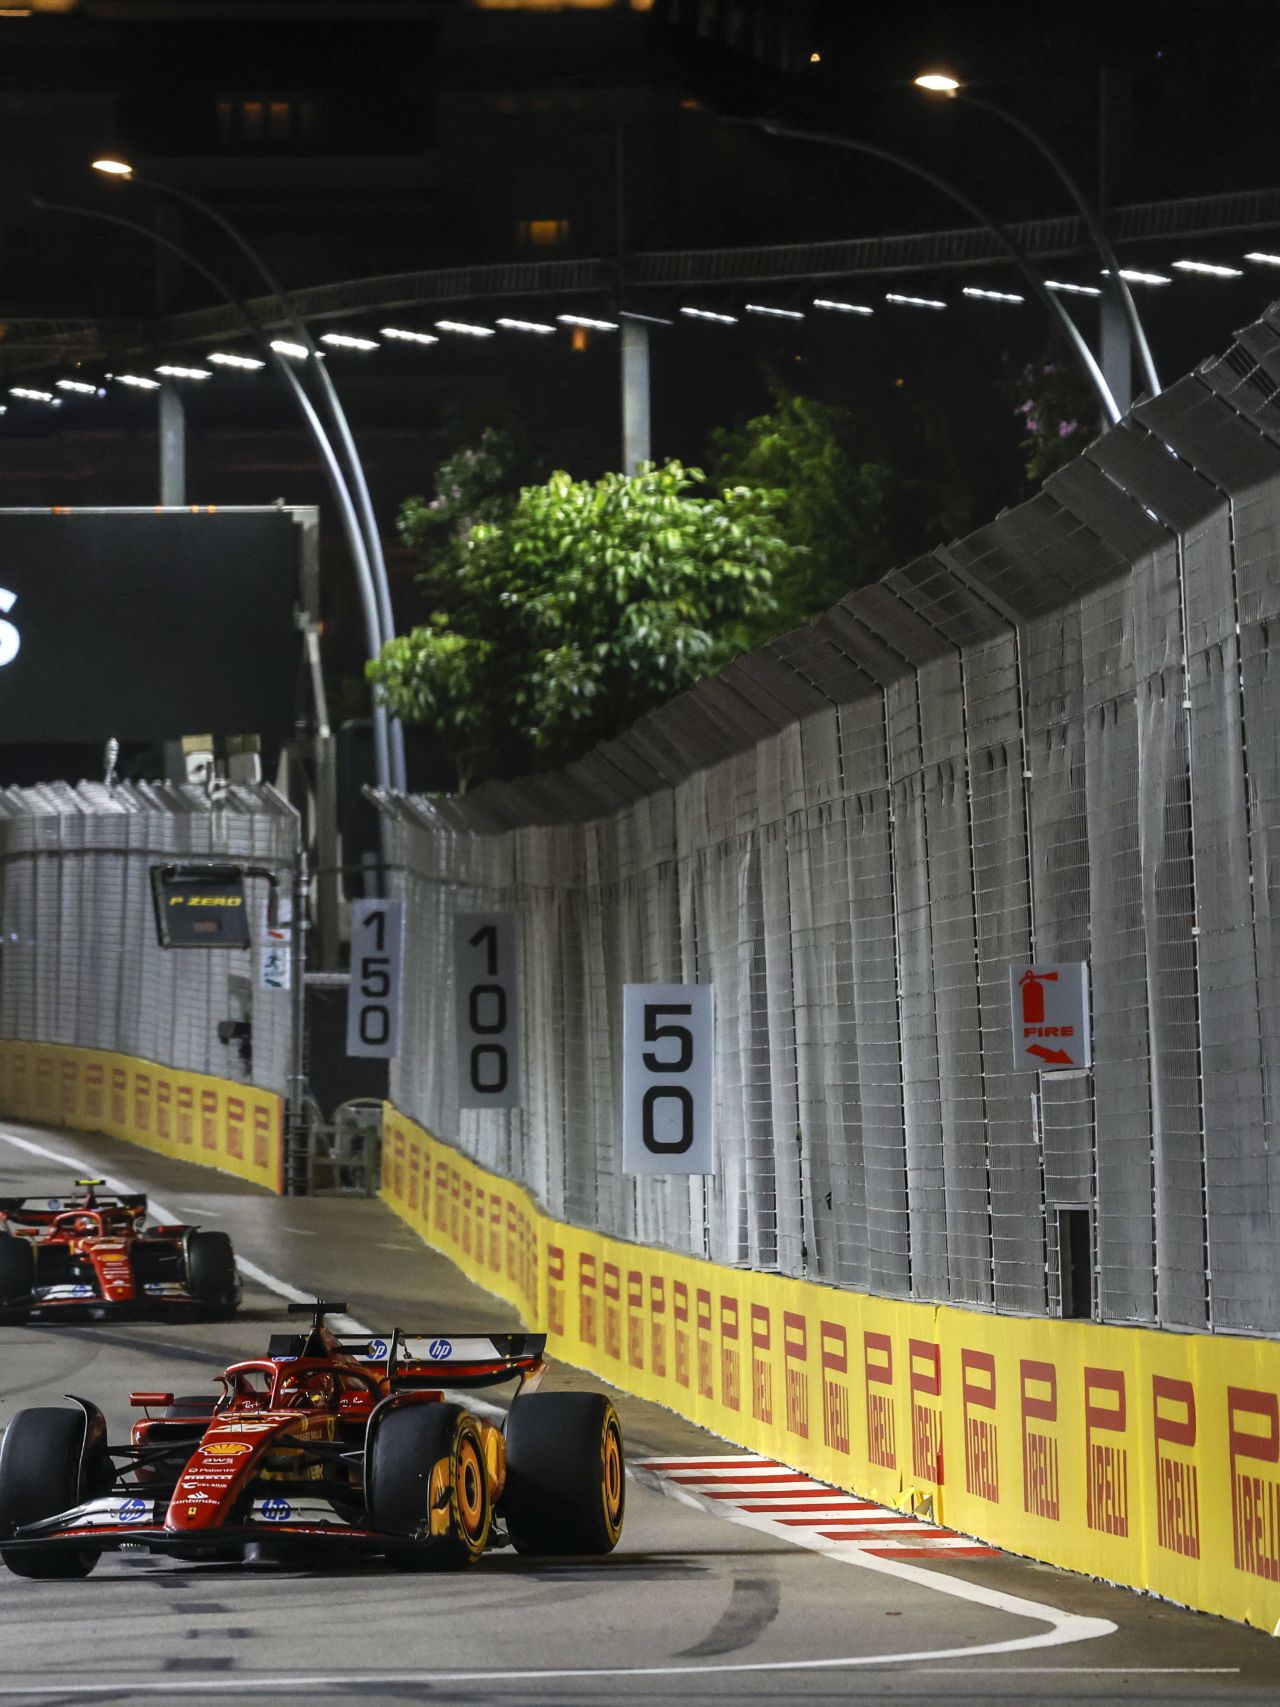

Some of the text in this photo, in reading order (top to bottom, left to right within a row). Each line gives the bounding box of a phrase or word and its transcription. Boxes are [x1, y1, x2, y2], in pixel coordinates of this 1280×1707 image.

[169, 895, 242, 906] P ZERO
[359, 911, 391, 1046] 150
[468, 925, 508, 1094] 100
[1023, 1026, 1074, 1038] FIRE
[641, 1003, 694, 1155] 50
[430, 1339, 451, 1360] hp
[820, 1320, 851, 1454] PIRELLI
[864, 1330, 898, 1470] PIRELLI
[909, 1338, 944, 1485] PIRELLI
[961, 1348, 999, 1504] PIRELLI
[1019, 1359, 1060, 1521] PIRELLI
[1084, 1366, 1129, 1538] PIRELLI
[1152, 1375, 1200, 1560] PIRELLI
[1227, 1386, 1280, 1582] PIRELLI
